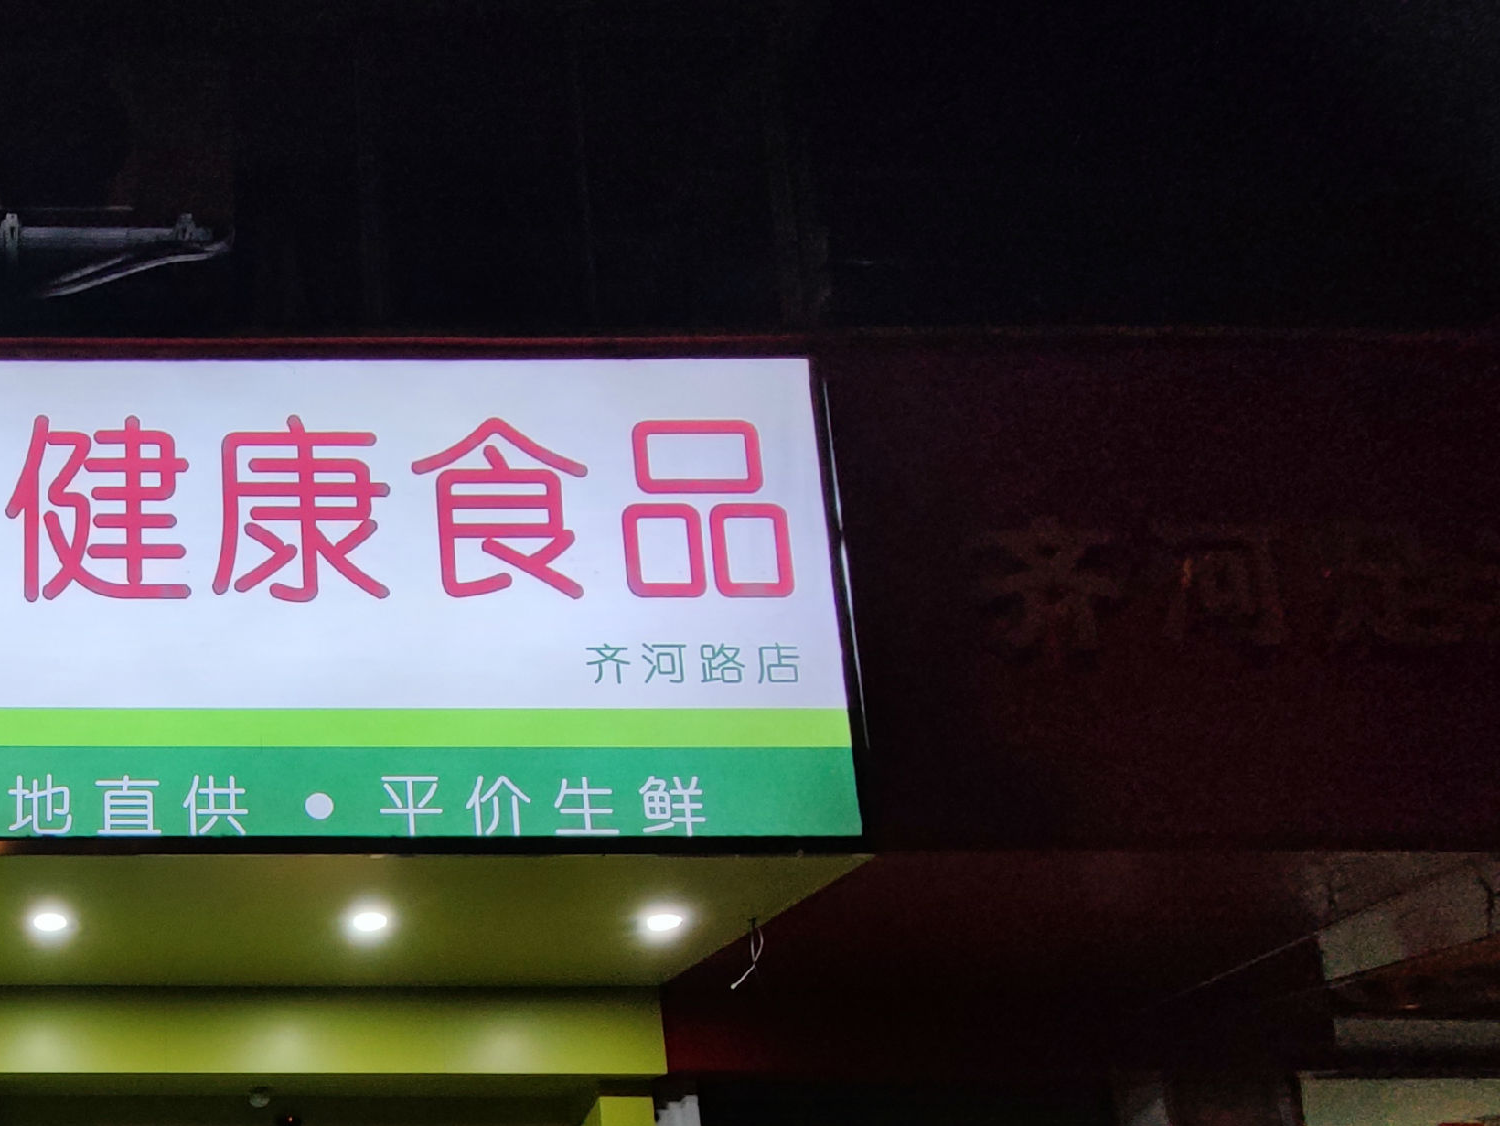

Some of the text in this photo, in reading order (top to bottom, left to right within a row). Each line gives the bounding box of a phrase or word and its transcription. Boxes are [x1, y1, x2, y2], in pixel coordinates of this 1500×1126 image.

[5, 415, 795, 602] 健康食品
[585, 643, 800, 685] 齐河路店
[379, 775, 706, 837] 平价生鲜
